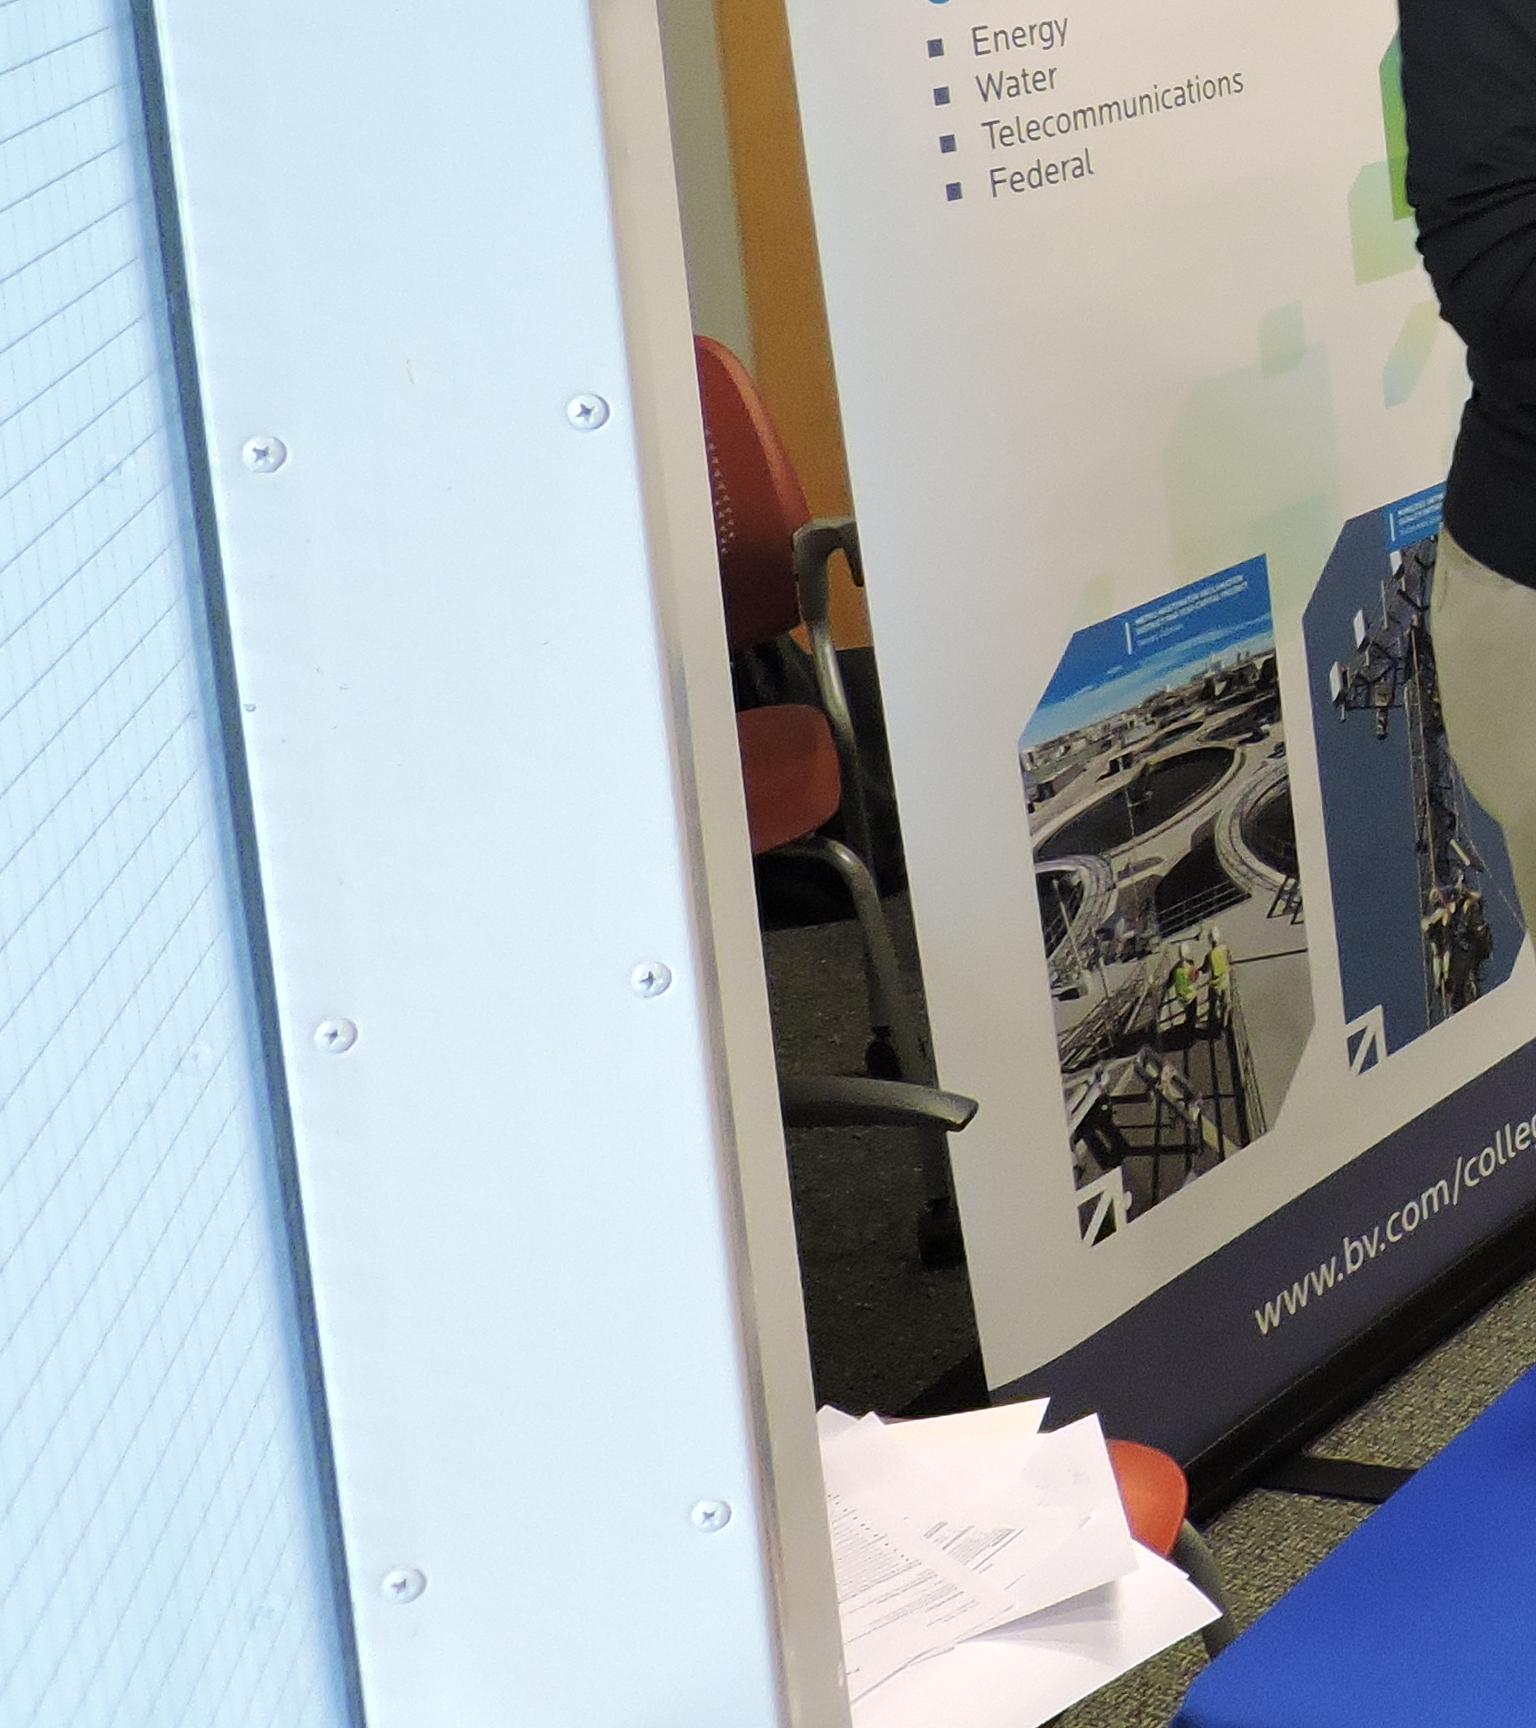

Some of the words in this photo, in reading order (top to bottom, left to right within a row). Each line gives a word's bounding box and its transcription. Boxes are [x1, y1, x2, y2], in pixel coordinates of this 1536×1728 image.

[971, 16, 1069, 58] Energy
[975, 64, 1058, 104] Water
[981, 69, 1245, 151] Telecommunications
[989, 149, 1095, 200] Federal
